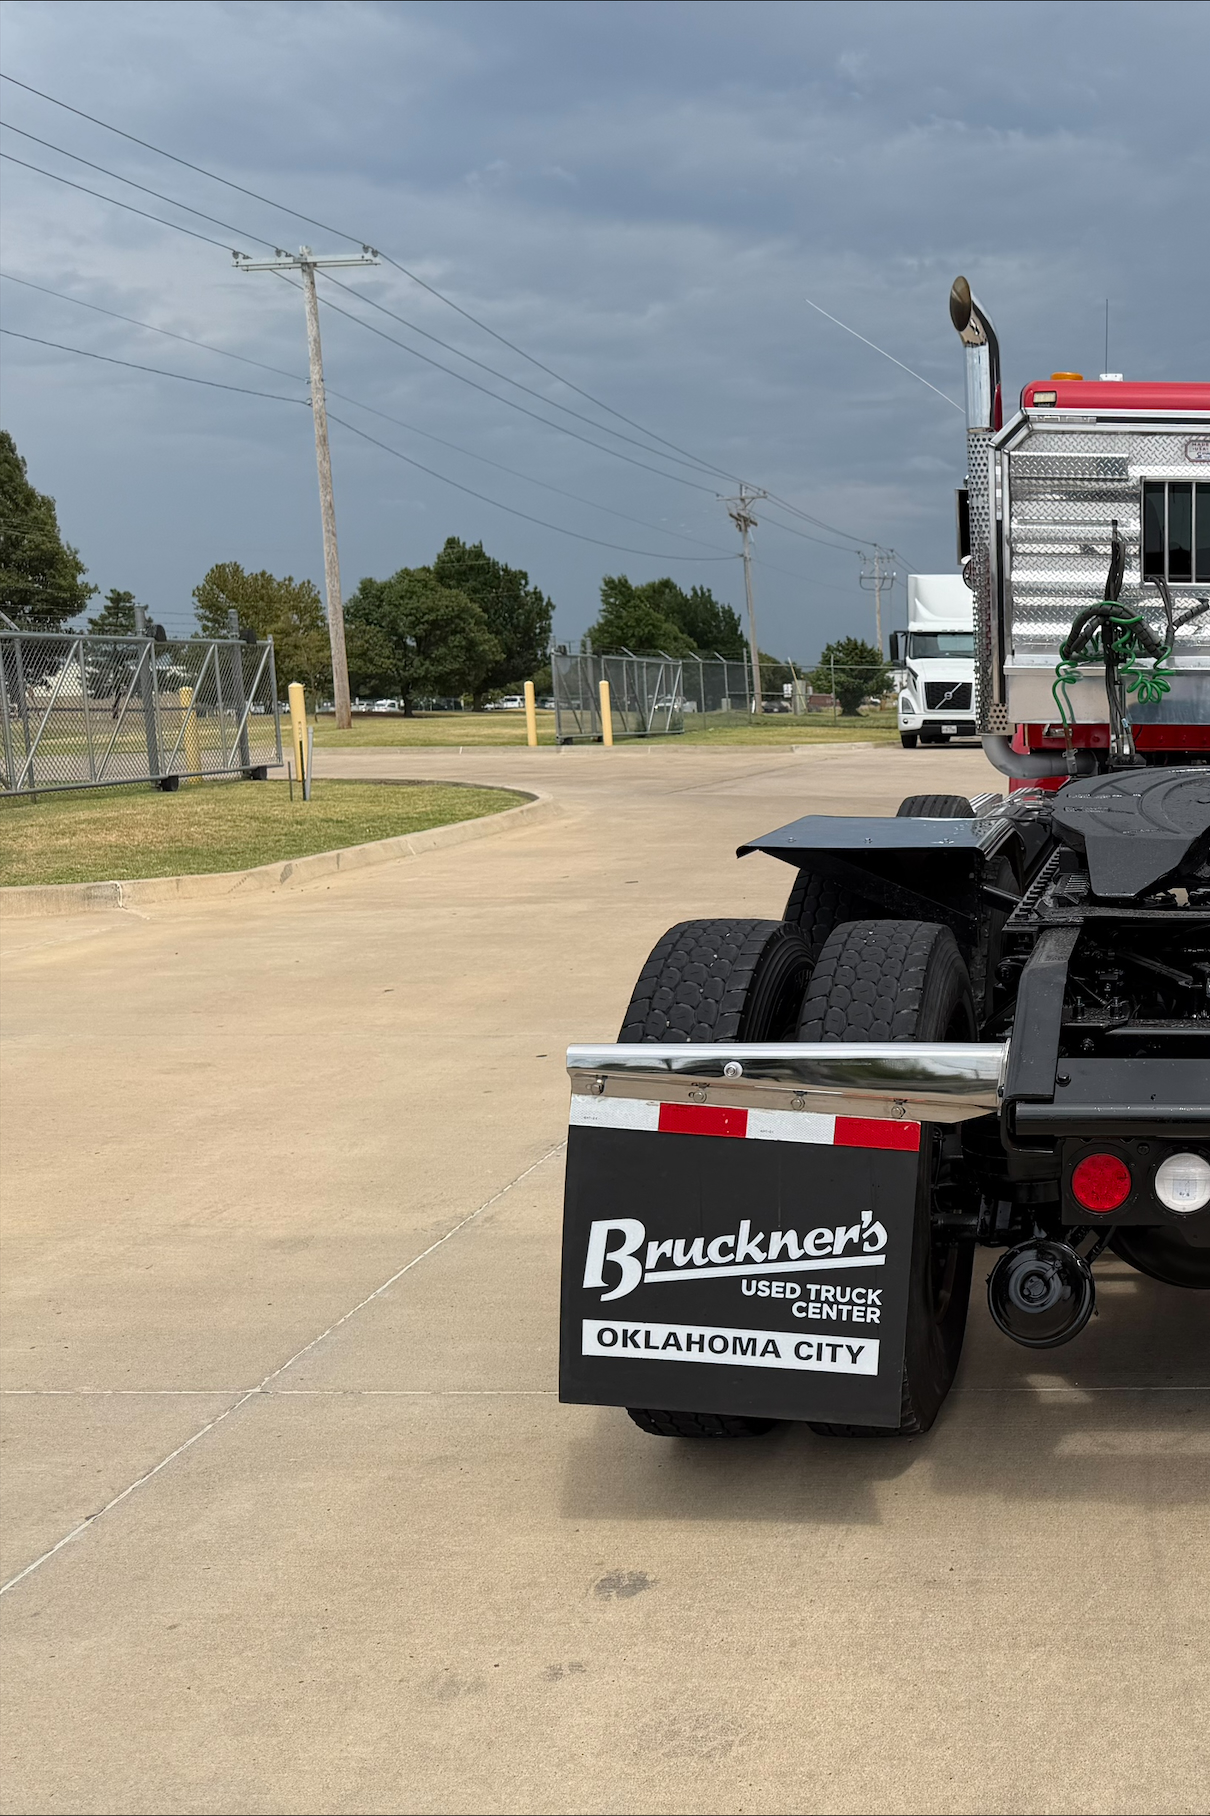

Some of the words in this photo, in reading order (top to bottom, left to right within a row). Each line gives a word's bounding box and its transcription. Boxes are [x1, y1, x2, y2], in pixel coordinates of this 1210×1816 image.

[582, 1210, 888, 1303] Bruckner's
[741, 1278, 802, 1299] USED
[805, 1282, 883, 1306] TRUCK
[791, 1301, 881, 1324] CENTER
[596, 1327, 782, 1359] OKLAHOMA
[794, 1341, 865, 1365] CITY
